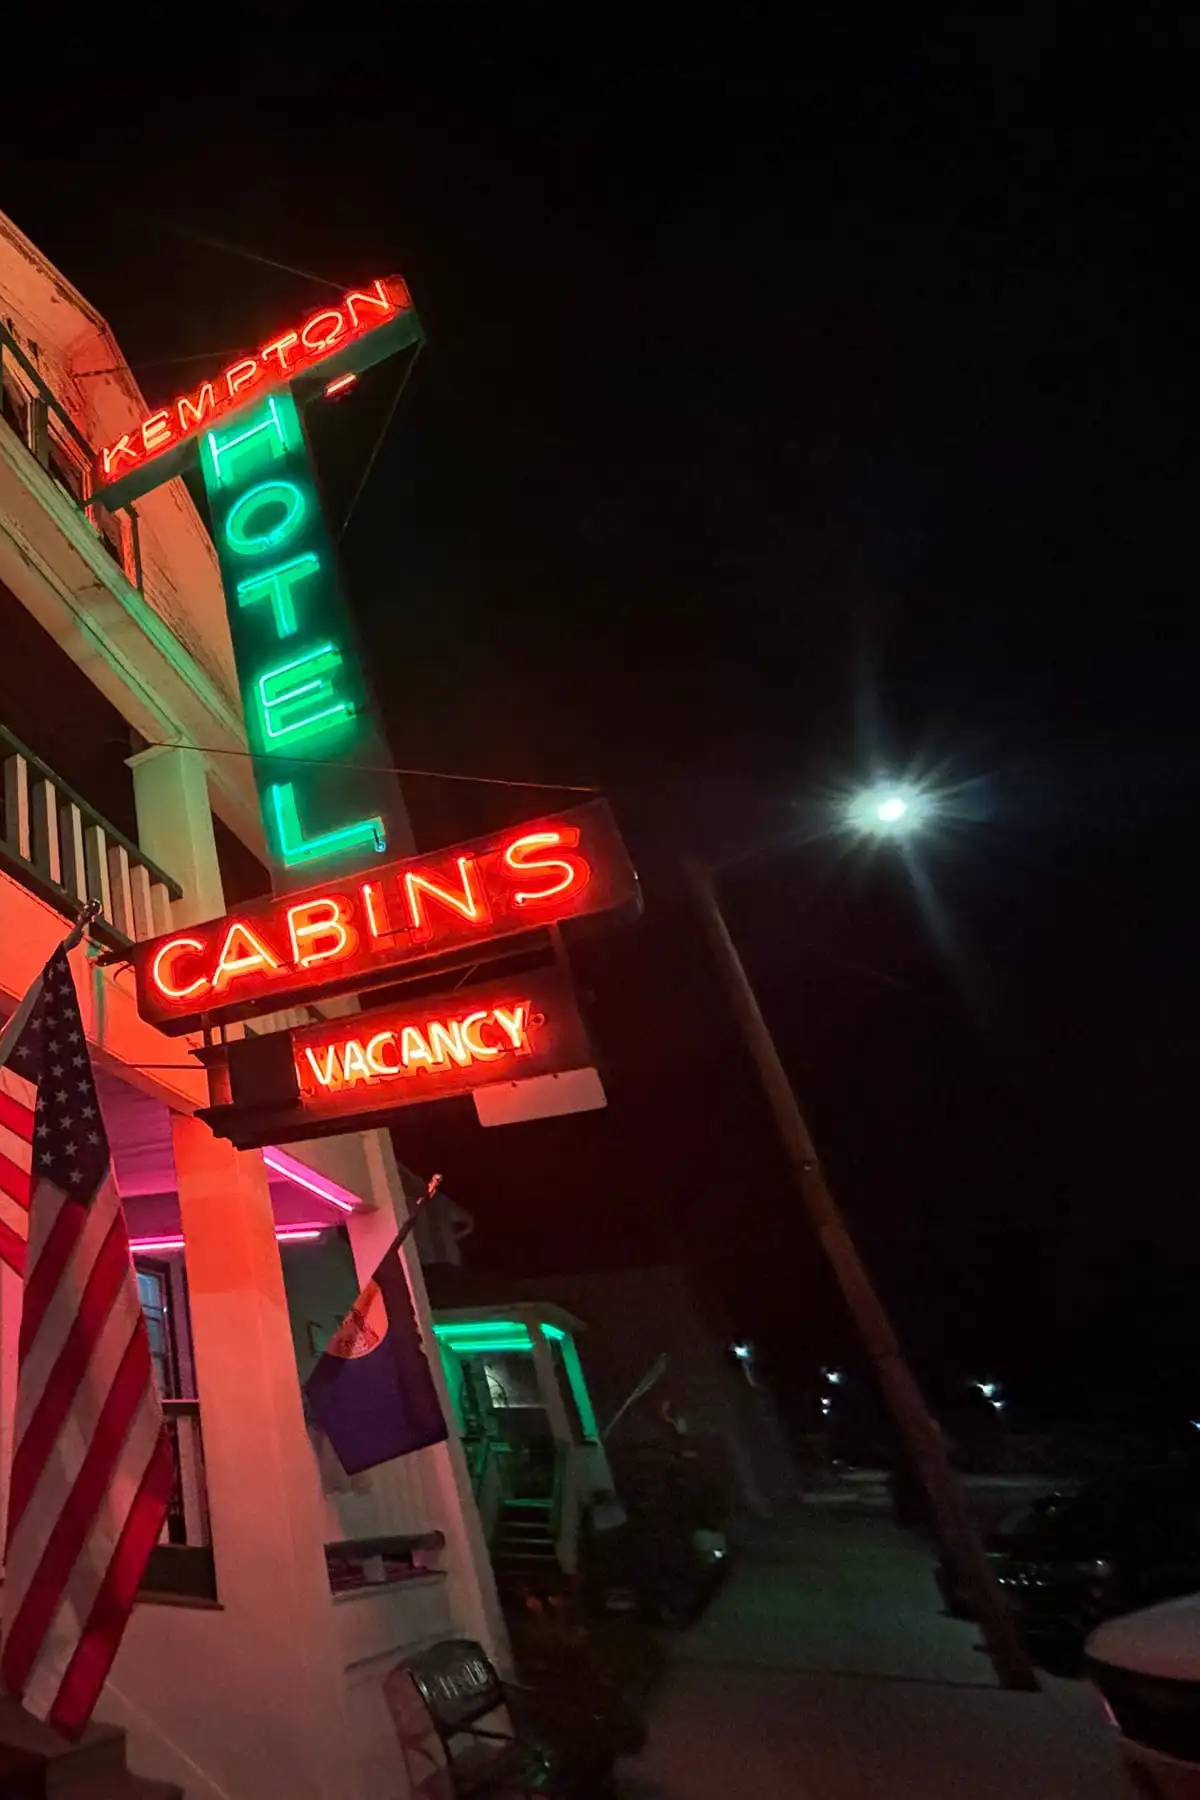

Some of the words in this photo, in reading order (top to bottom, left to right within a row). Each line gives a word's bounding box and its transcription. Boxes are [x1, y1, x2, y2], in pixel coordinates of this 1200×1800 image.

[101, 278, 393, 475] KEMPTON
[204, 394, 386, 867] HOTEL
[151, 828, 590, 1001] CABINS
[305, 1004, 532, 1089] VACANCY
